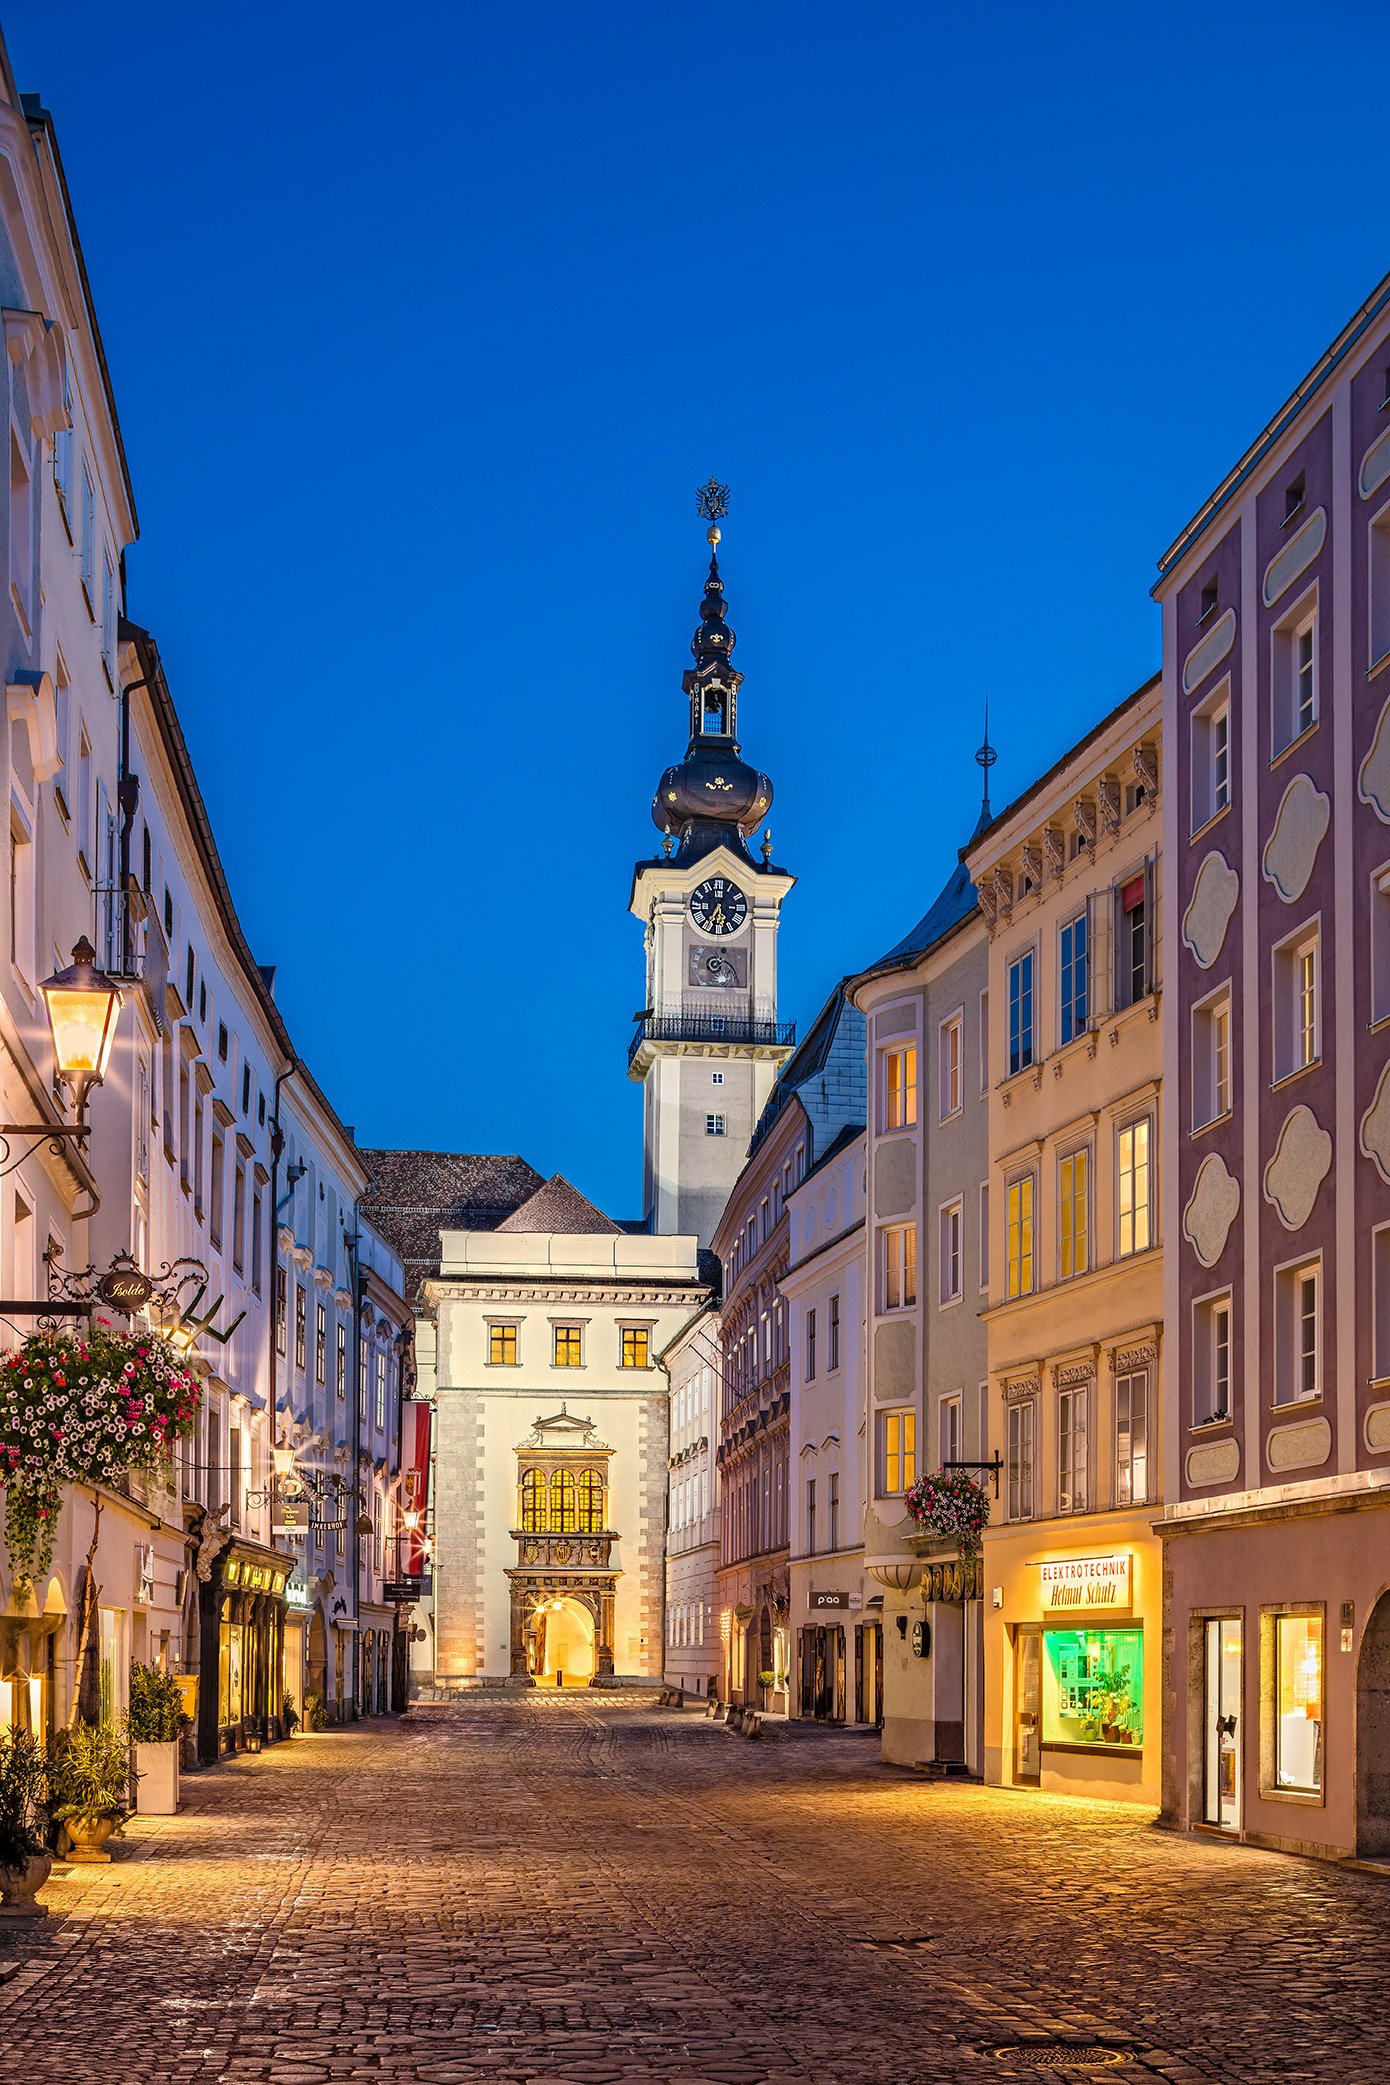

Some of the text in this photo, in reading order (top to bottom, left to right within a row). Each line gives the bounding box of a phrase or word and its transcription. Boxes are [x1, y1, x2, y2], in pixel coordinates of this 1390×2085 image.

[105, 1281, 145, 1298] Isolde
[311, 1521, 343, 1531] IMKERHOF
[1043, 1561, 1126, 1580] ELEKTROTECHNIK
[1050, 1584, 1083, 1606] Helmut
